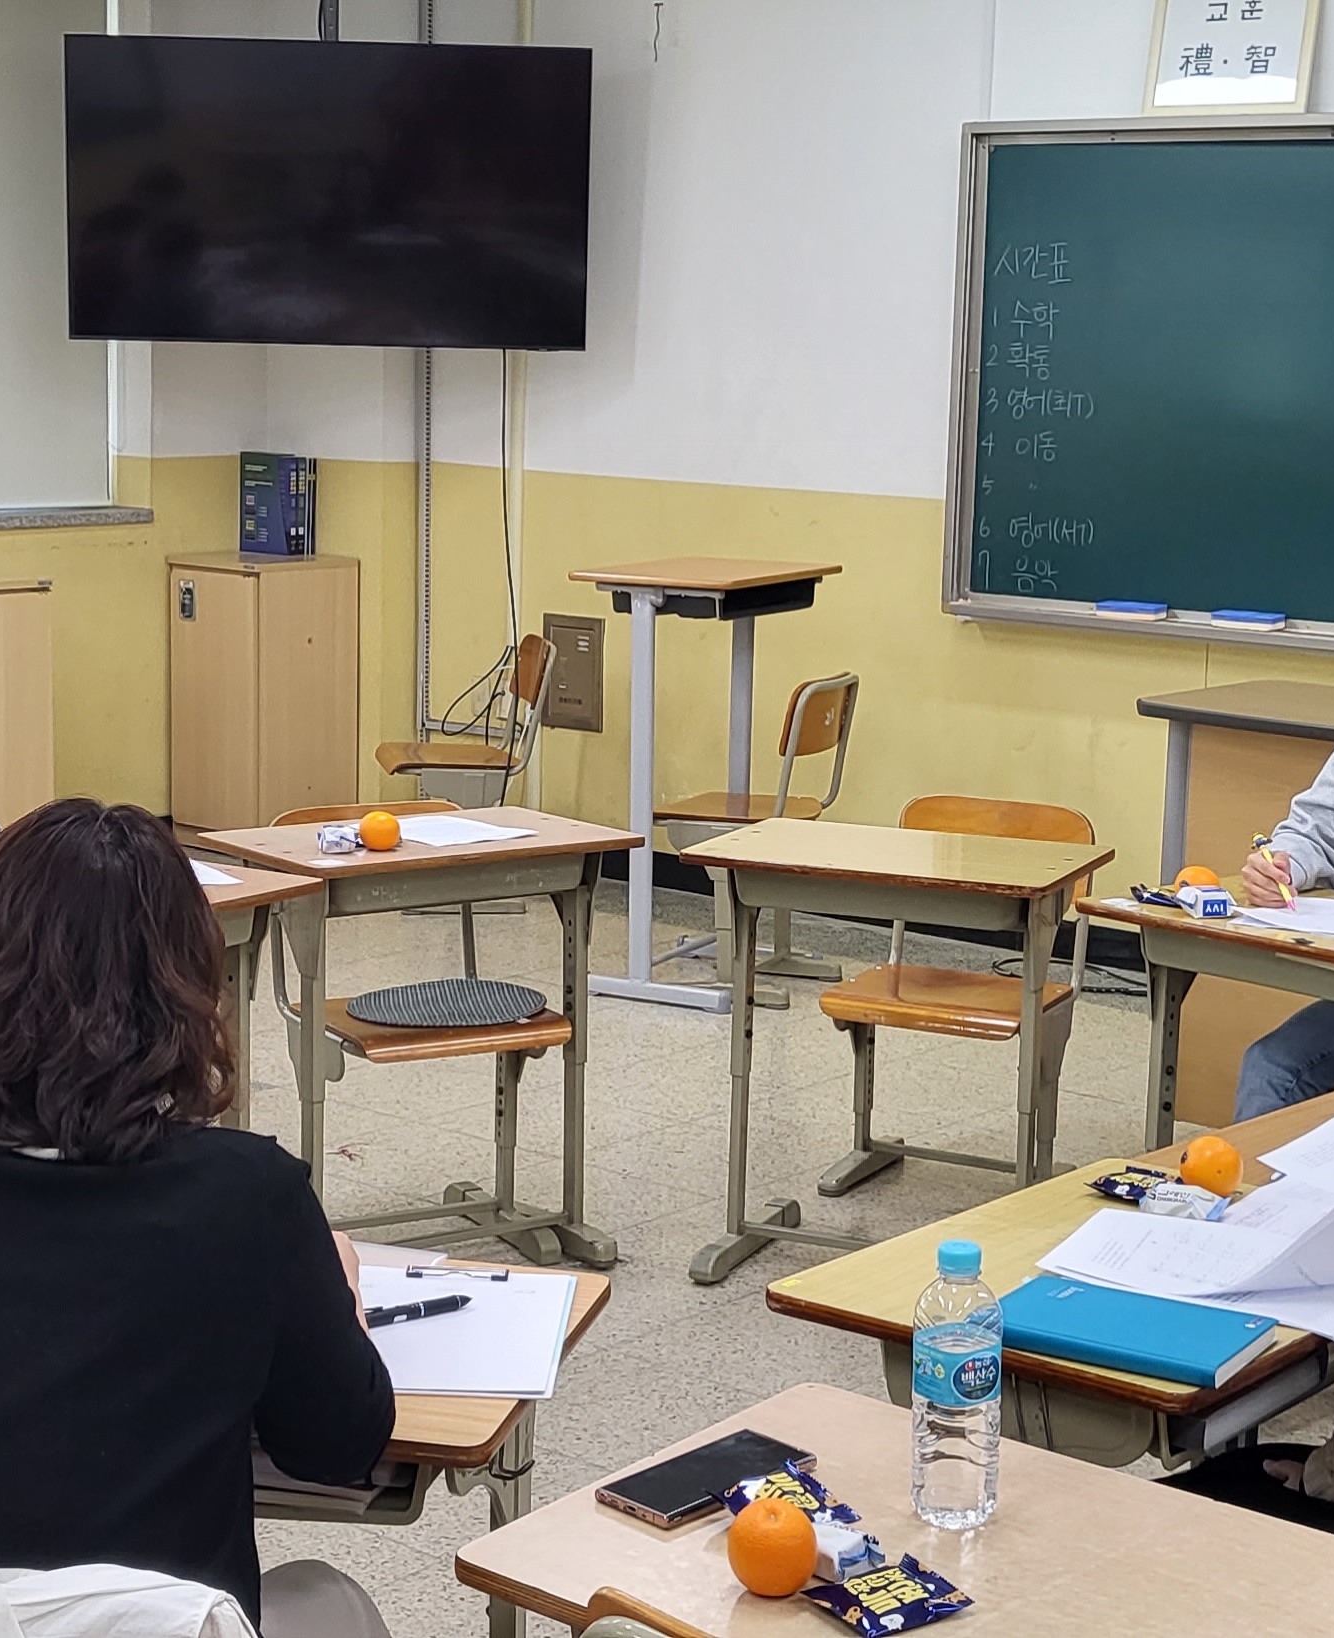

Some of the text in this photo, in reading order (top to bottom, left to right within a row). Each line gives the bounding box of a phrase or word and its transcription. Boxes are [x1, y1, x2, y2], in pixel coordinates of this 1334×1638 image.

[994, 242, 1071, 284] 시간표
[1011, 301, 1060, 340] 수학
[985, 342, 1051, 380] 2 확통
[985, 388, 999, 413] 3
[981, 431, 1057, 462] 4 이동
[982, 478, 995, 495] 5
[979, 517, 990, 538] 6
[978, 550, 1058, 592] 7 음악
[1205, 903, 1224, 913] IVY
[961, 1365, 997, 1387] 백산수
